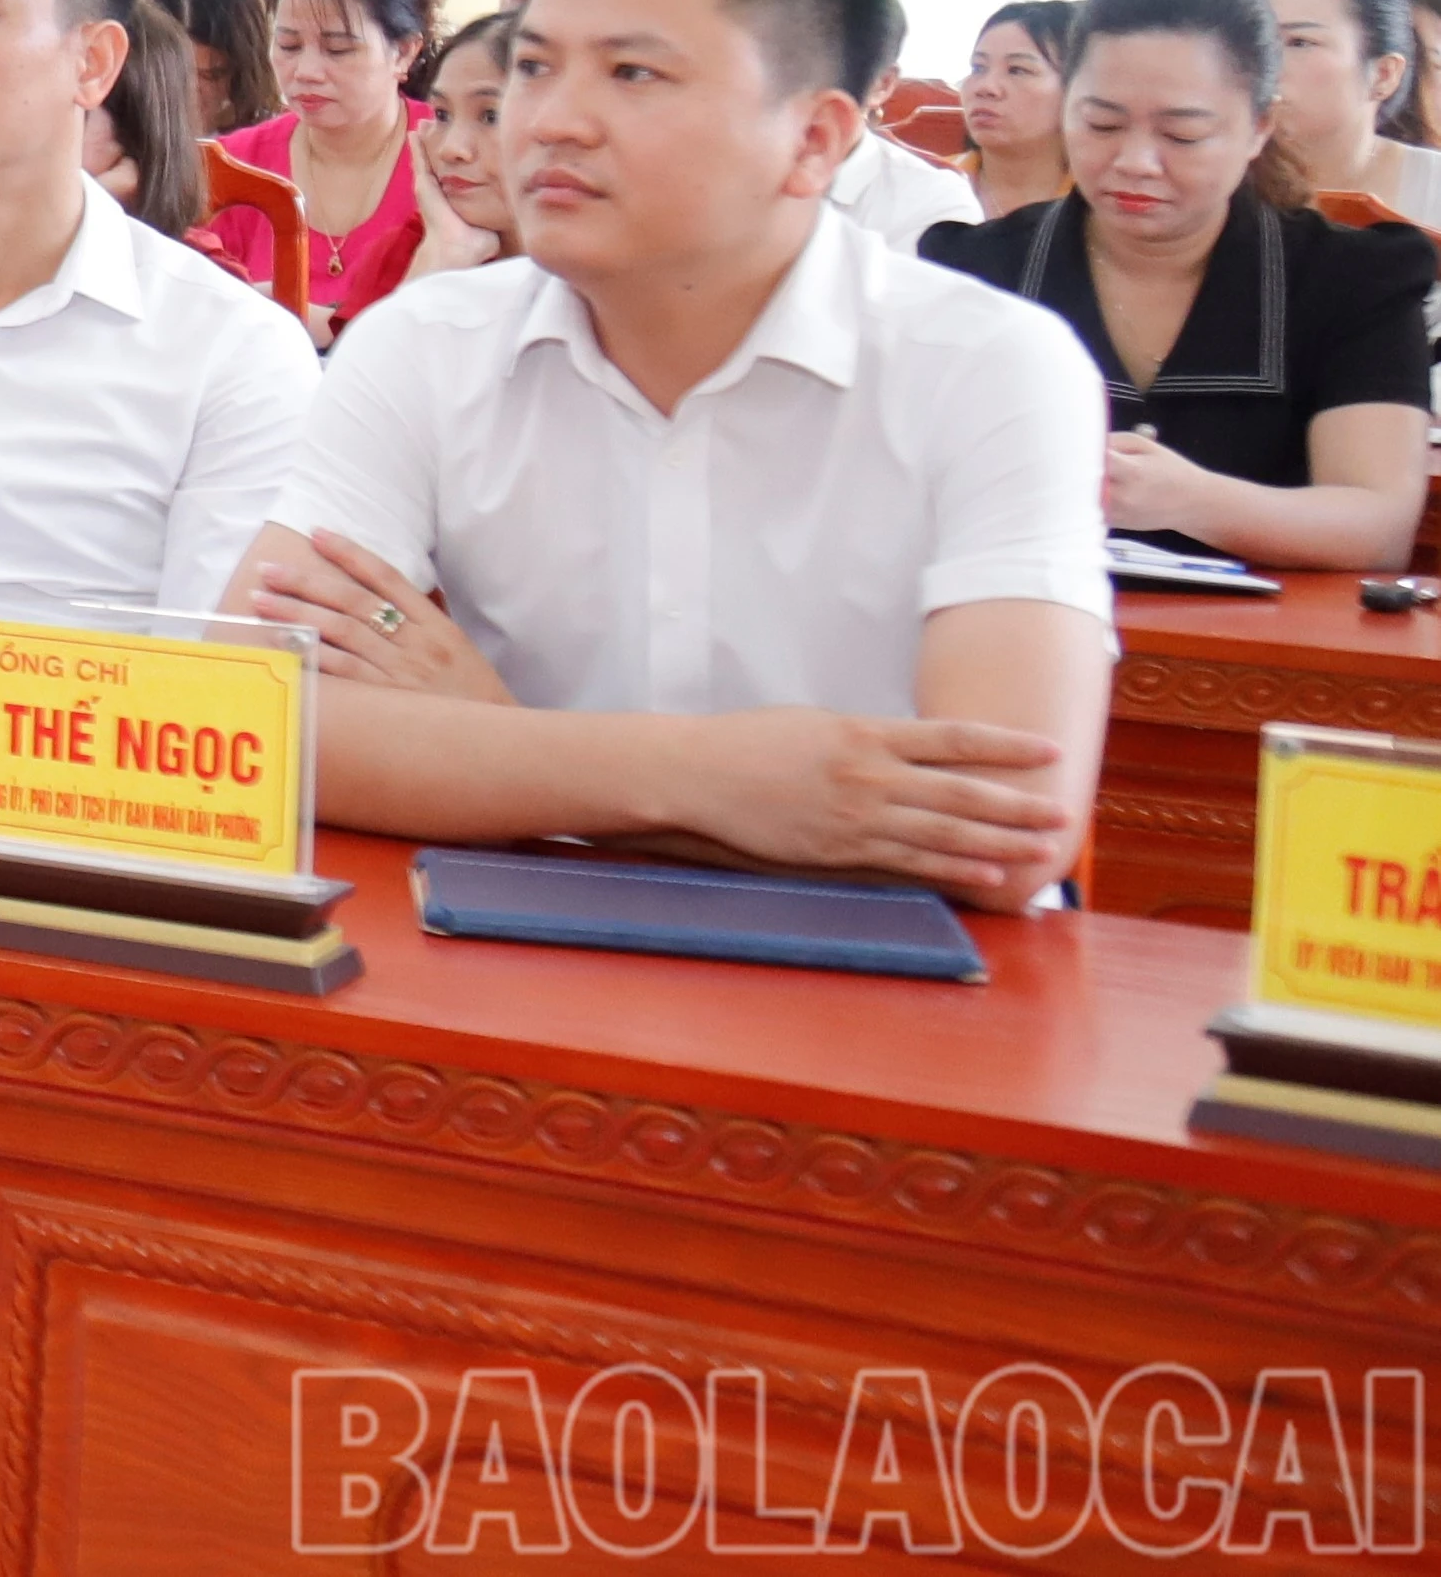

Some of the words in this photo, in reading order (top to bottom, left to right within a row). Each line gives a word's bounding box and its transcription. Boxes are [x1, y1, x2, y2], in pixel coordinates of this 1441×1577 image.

[76, 658, 130, 687] CHÍ
[4, 695, 102, 766] THẾ
[116, 716, 264, 794] NGỌC
[126, 800, 150, 828] BAN
